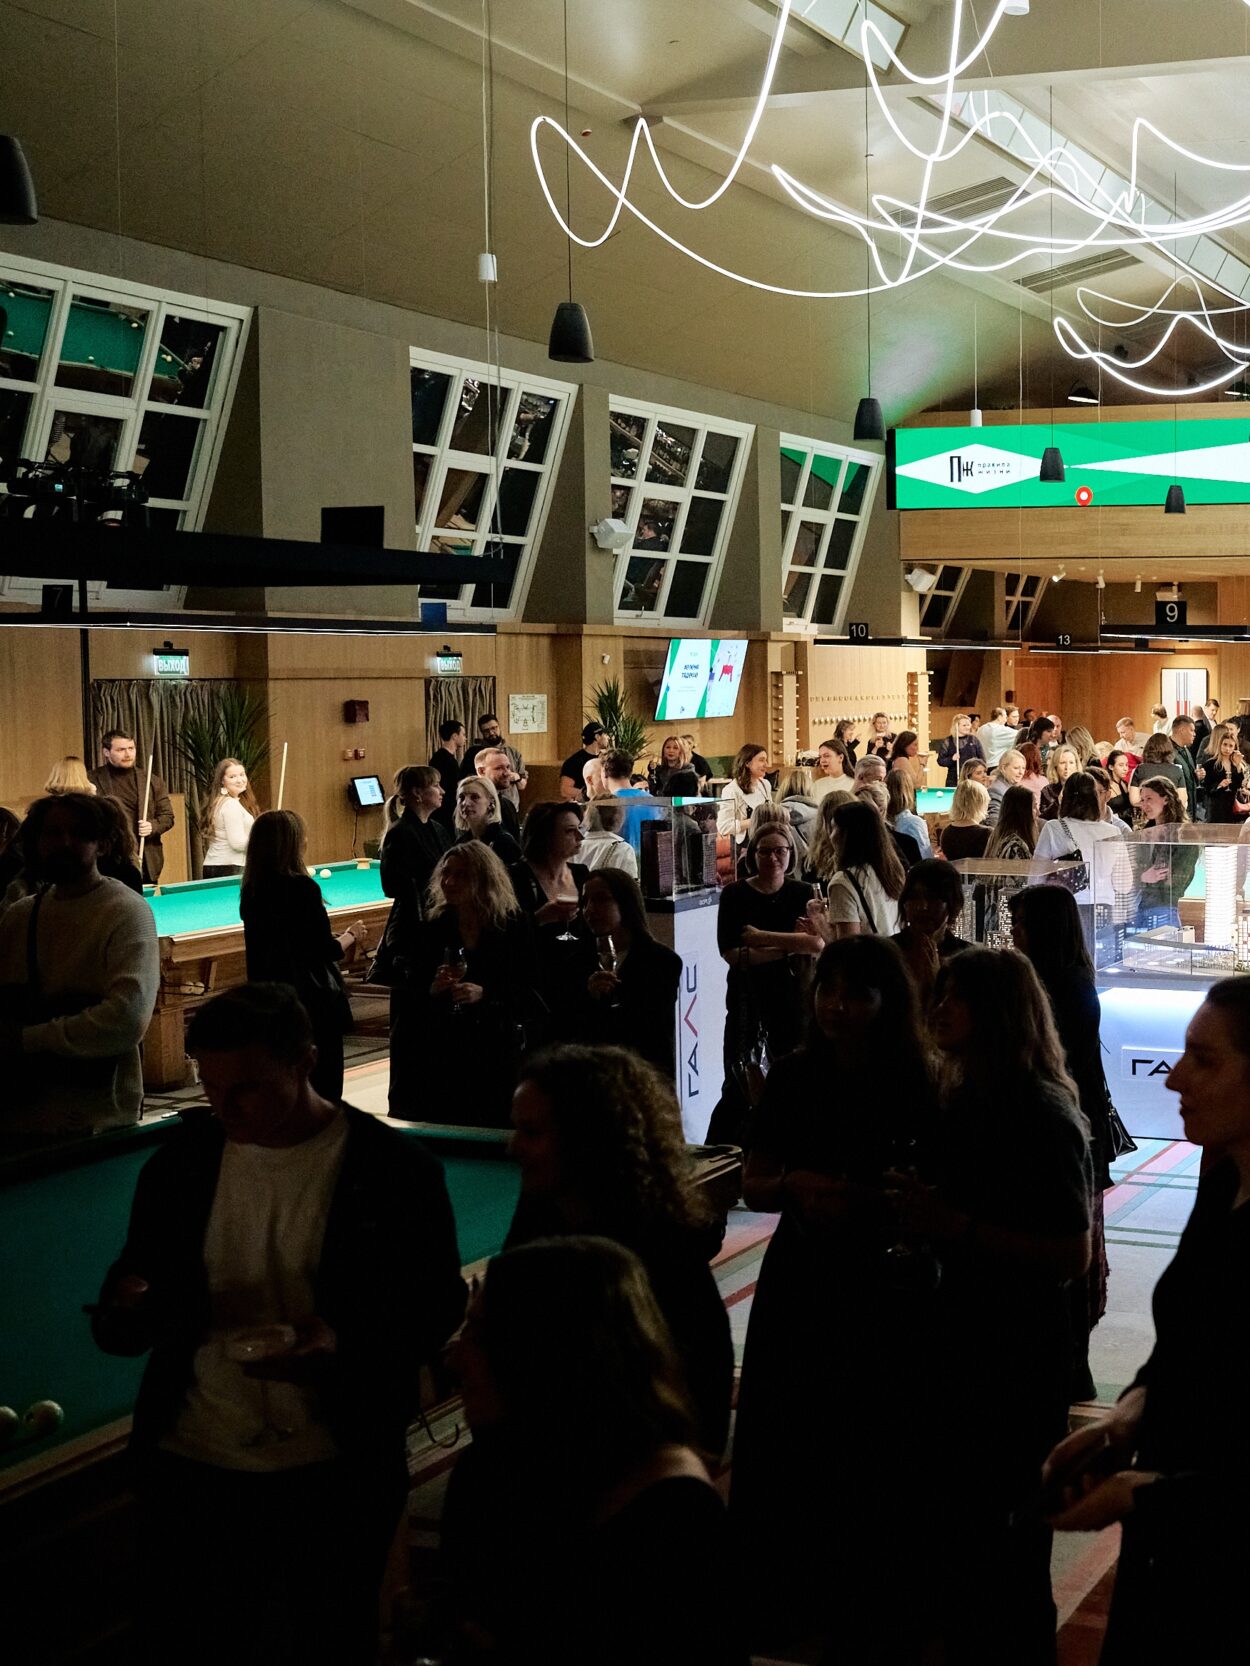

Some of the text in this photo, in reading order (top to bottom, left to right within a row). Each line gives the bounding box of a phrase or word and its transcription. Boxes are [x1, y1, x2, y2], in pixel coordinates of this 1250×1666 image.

[949, 455, 974, 482] ПЖ
[52, 587, 63, 608] 7
[1166, 603, 1178, 622] 9
[851, 624, 866, 637] 10
[1058, 634, 1071, 645] 13
[158, 659, 186, 673] ВЫХОД
[1131, 1058, 1172, 1077] ГА
